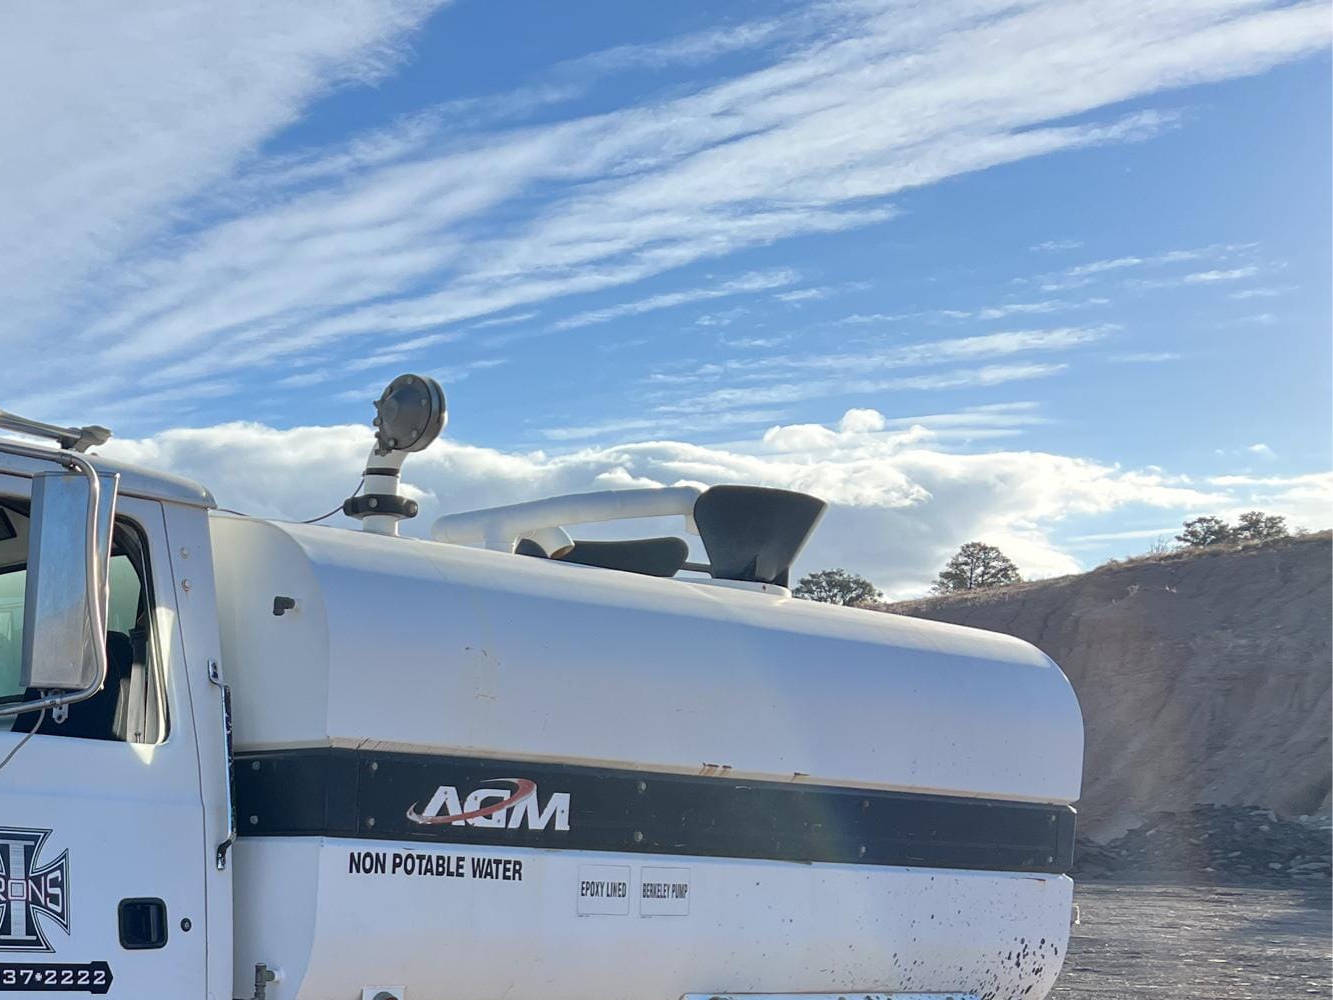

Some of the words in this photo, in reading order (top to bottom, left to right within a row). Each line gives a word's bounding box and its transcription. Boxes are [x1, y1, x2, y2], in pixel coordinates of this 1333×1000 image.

[420, 784, 571, 832] AGM
[349, 852, 386, 874] NON
[392, 853, 465, 878] POTABLE
[471, 857, 523, 881] WATER
[580, 881, 605, 897] EPOXY
[606, 882, 627, 898] LINED
[642, 883, 671, 899] BERKELEY
[671, 883, 688, 899] PUMP
